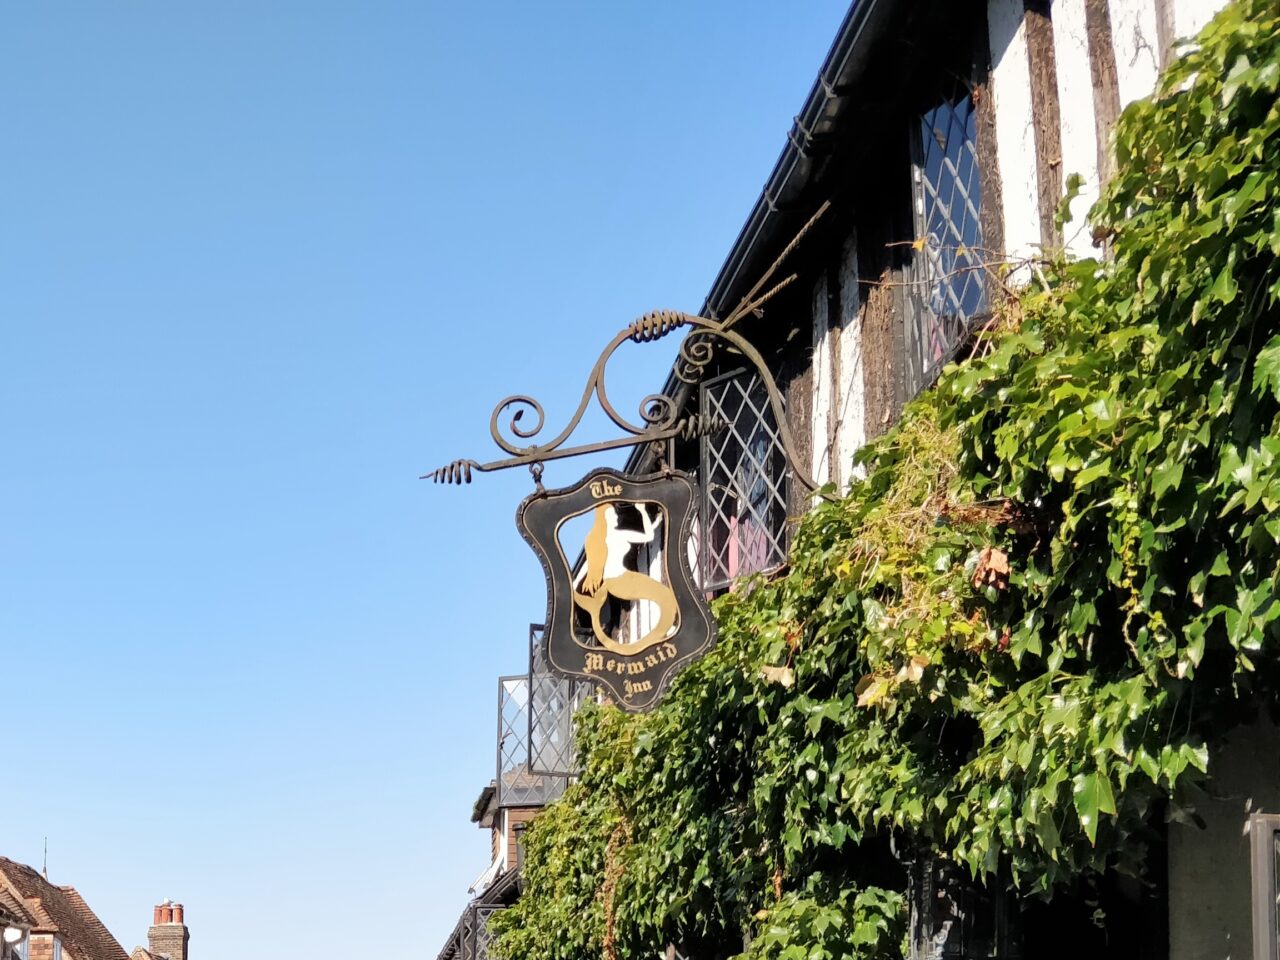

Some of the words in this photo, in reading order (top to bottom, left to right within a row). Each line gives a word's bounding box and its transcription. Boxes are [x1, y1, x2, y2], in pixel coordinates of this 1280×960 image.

[590, 480, 623, 498] The
[583, 642, 677, 673] Mermaid
[623, 679, 653, 702] Inn
